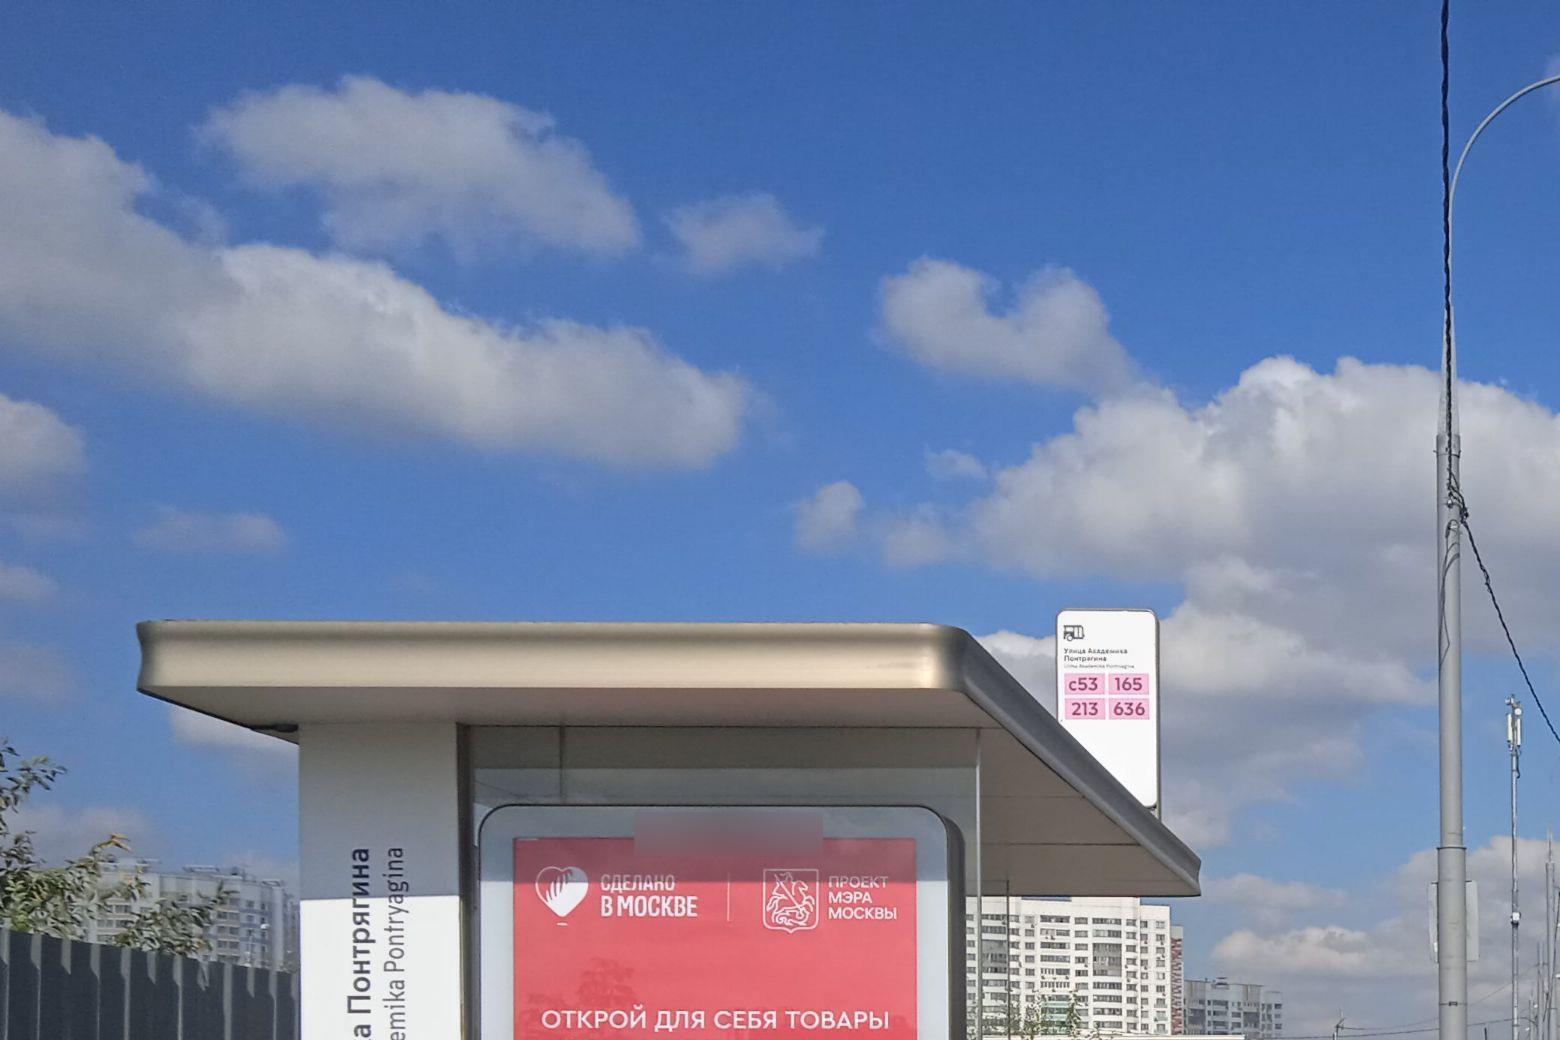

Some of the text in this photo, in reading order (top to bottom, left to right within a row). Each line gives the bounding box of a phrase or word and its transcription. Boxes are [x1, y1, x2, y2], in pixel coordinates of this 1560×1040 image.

[1069, 677, 1143, 691] с53 165
[1071, 702, 1146, 716] 213 636
[600, 874, 675, 892] СДЕЛАНО
[828, 875, 889, 888] ПРОЕКТ
[828, 891, 872, 904] МЭРА
[382, 847, 410, 973] Pontryagina
[600, 896, 698, 917] В МОСКВЕ
[828, 907, 897, 920] МОСКВЫ
[346, 848, 377, 1015] Понтрягина
[541, 1004, 889, 1033] ОТКРОЙ ДЛЯ СЕБЯ ТОВАРЫ
